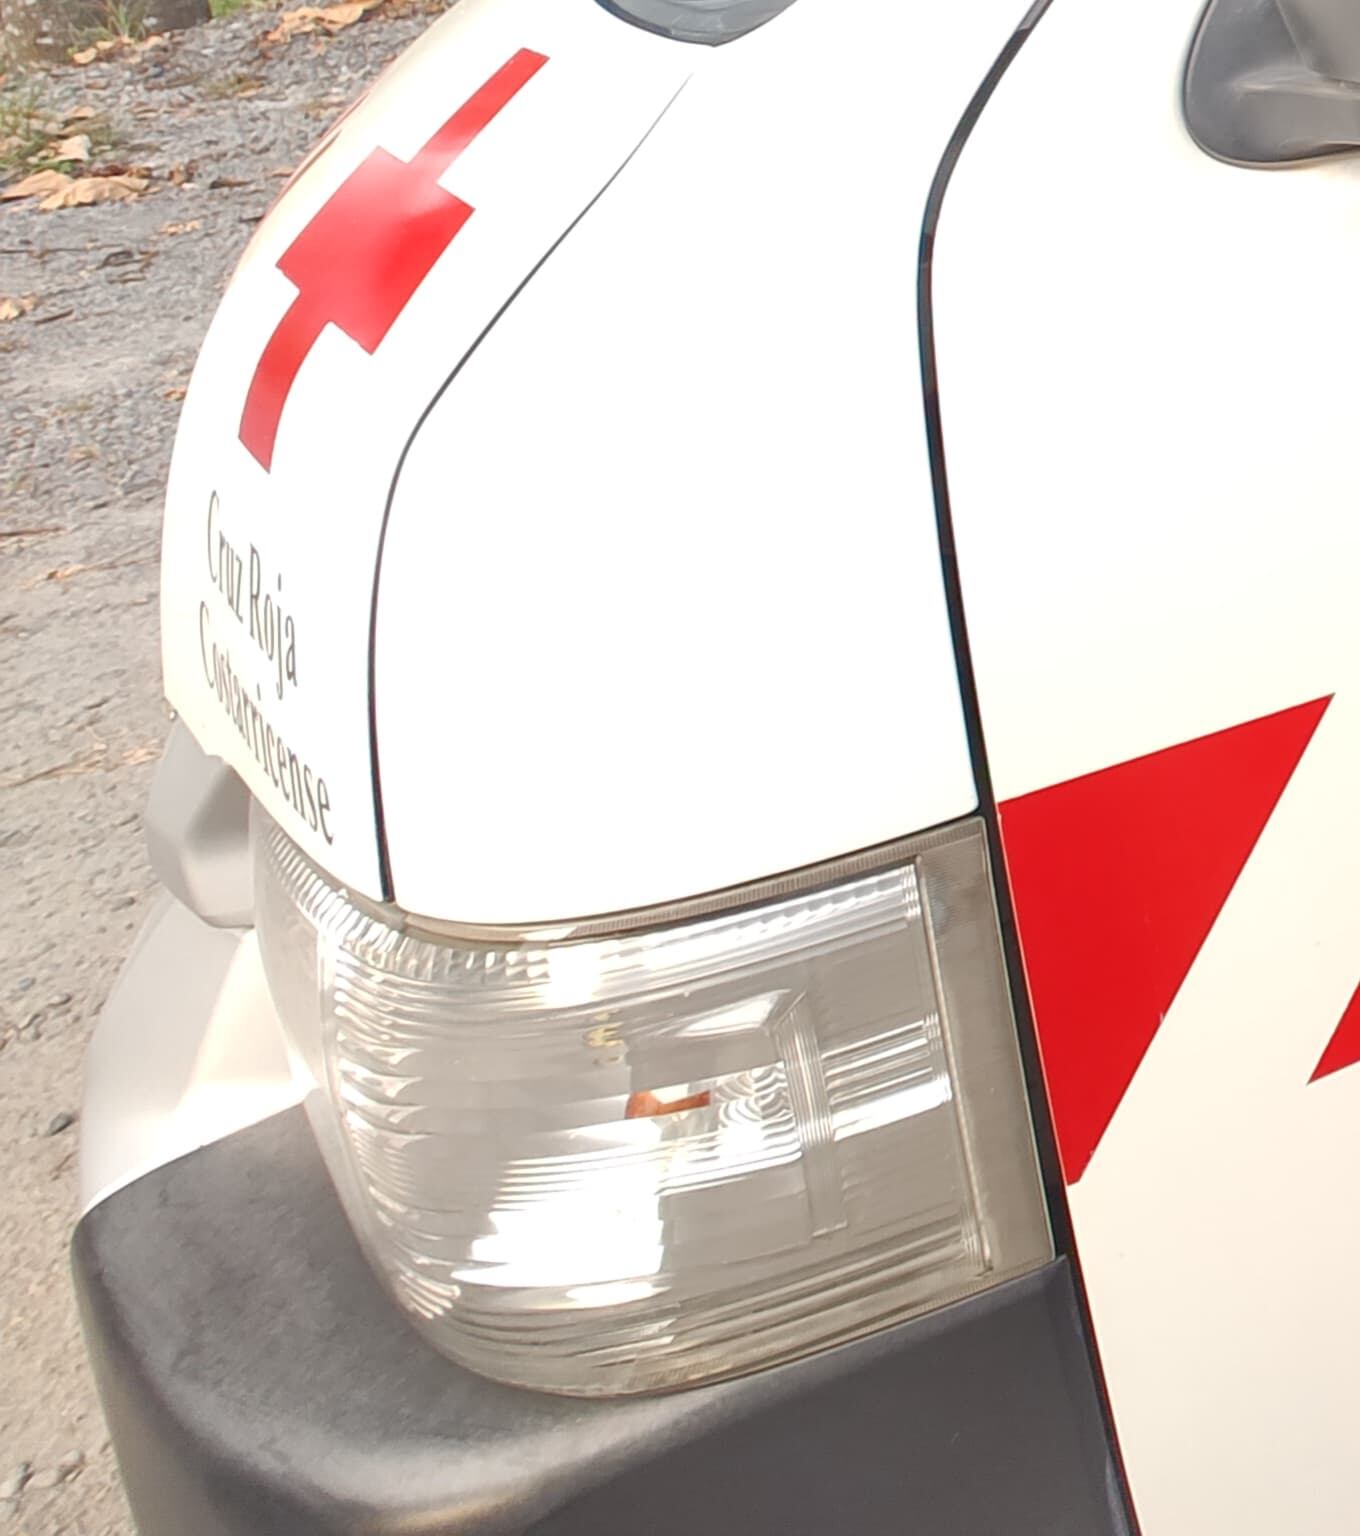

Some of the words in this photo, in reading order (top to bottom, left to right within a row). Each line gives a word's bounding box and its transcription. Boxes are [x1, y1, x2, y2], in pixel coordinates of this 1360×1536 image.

[207, 490, 243, 624] Cruz
[249, 542, 298, 700] Roja
[200, 600, 334, 846] Costarricense
